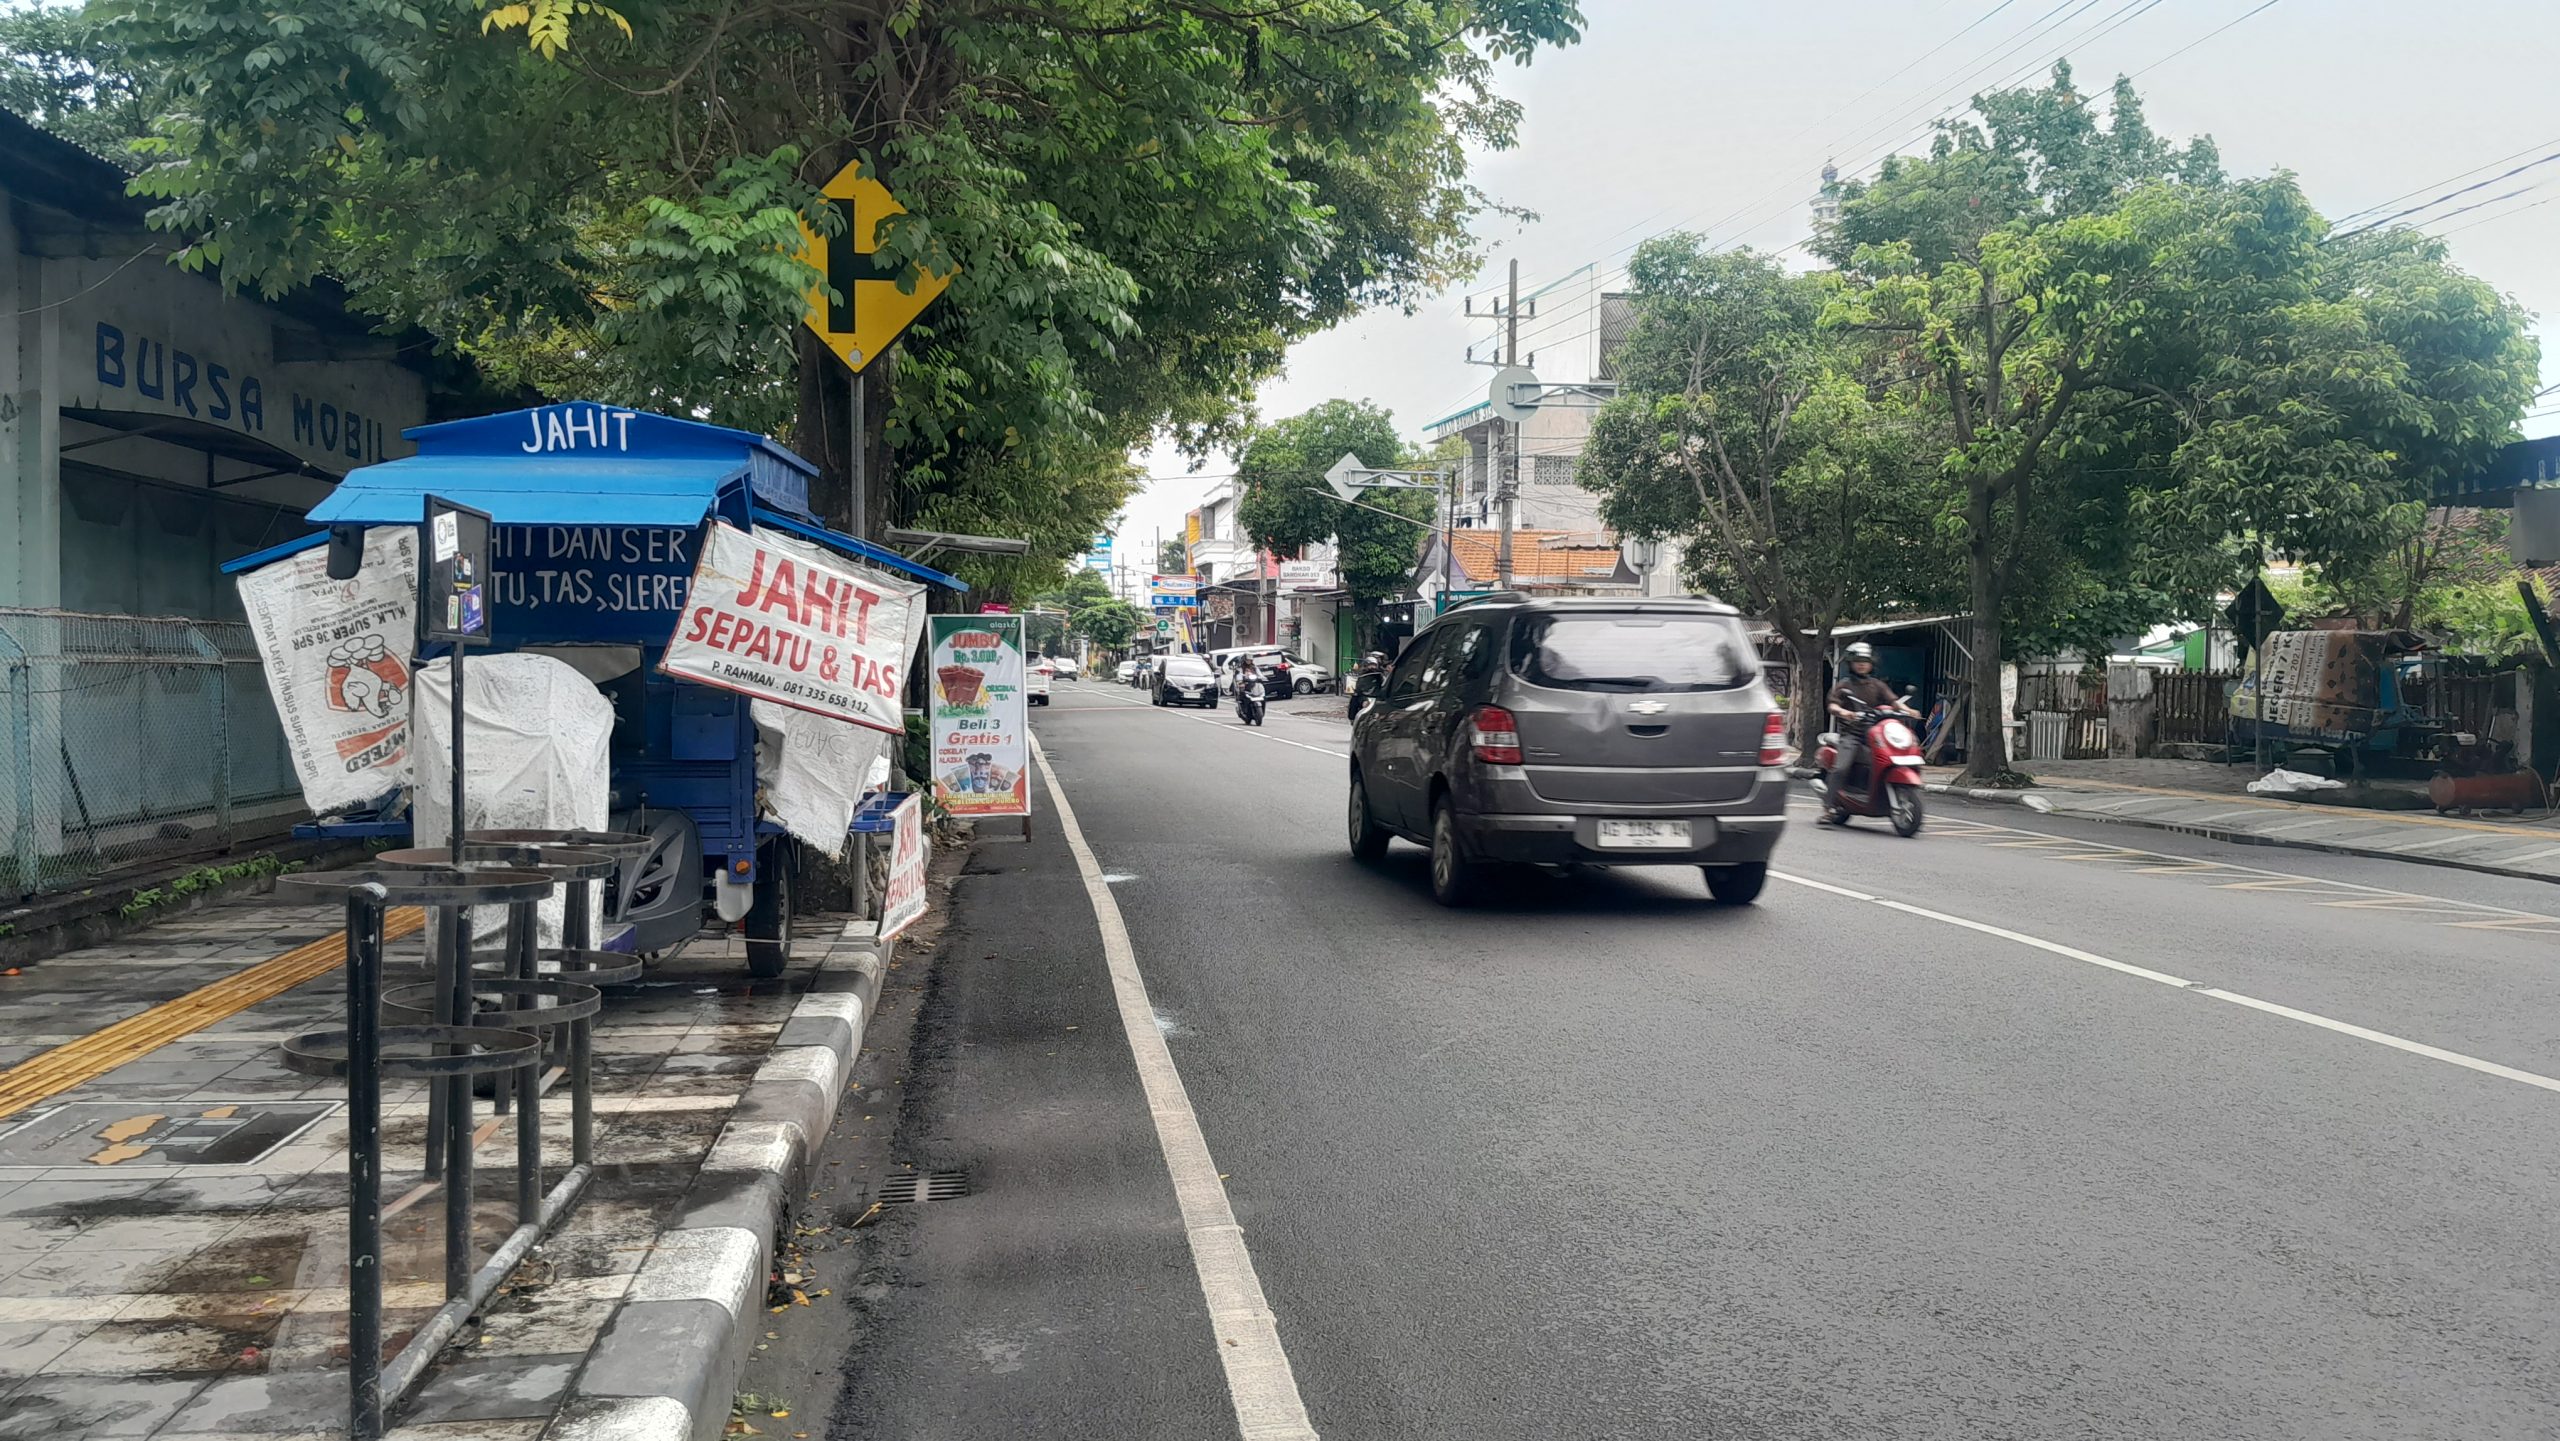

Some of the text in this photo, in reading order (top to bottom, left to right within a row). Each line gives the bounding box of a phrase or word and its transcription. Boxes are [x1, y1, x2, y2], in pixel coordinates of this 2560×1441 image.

[96, 321, 387, 463] BURSA MOBIL
[522, 405, 636, 453] JAHIT
[548, 527, 612, 561] DAN
[736, 549, 880, 645] JAHIT
[292, 606, 407, 651] K.L.K. SUPER 36 SPR
[948, 632, 1001, 649] JUMBO
[268, 641, 285, 678] LAYER
[686, 606, 895, 699] SEPATU & TAS
[953, 650, 970, 665] Rp.
[2278, 654, 2288, 664] 7
[278, 676, 298, 714] KHUSUS
[711, 660, 720, 673] P.
[724, 665, 775, 688] RAHMAN
[783, 681, 803, 696] 081
[805, 685, 826, 701] 335
[828, 691, 847, 707] 658
[851, 699, 869, 713] 112
[986, 685, 1018, 693] ORIGINAL
[994, 693, 1009, 701] TEA
[290, 714, 308, 747] SUPER
[948, 732, 1013, 746] Gratis 1
[958, 719, 1001, 730] Beli 3
[300, 746, 312, 761] 36
[304, 760, 320, 780] SPR
